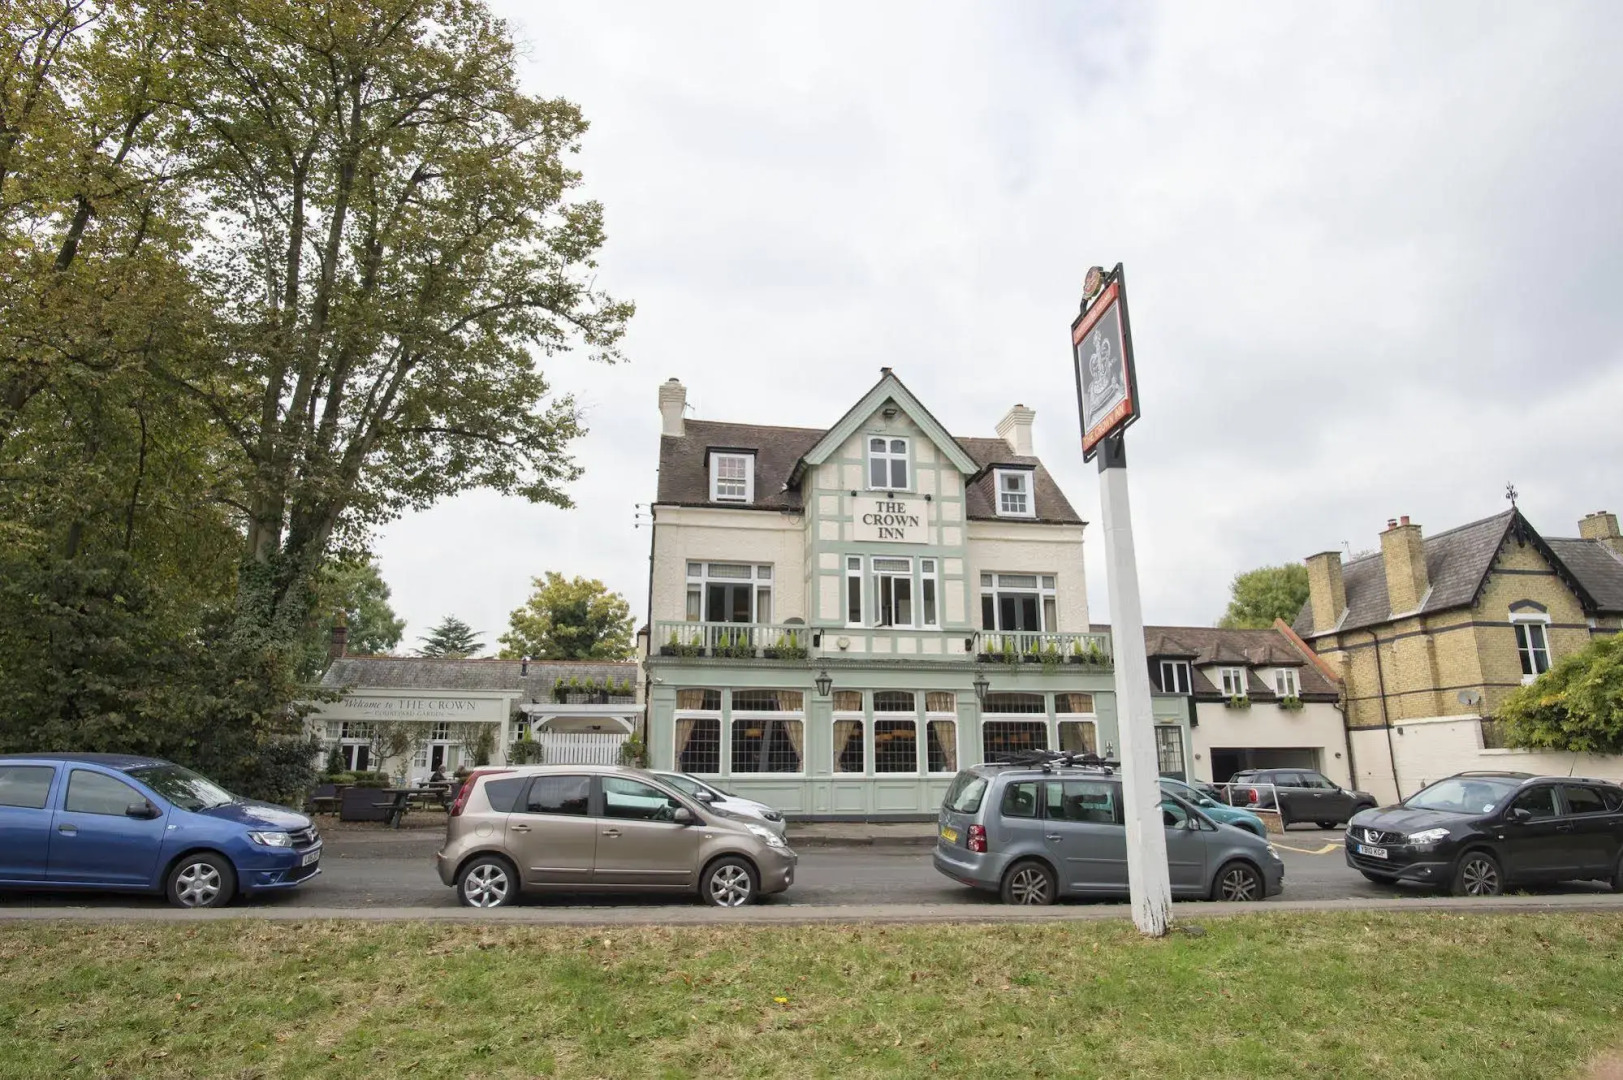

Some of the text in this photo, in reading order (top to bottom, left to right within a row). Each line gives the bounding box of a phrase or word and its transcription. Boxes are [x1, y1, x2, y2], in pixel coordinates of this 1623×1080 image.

[875, 501, 906, 513] THE
[862, 514, 919, 527] CROWN
[878, 527, 904, 539] INN
[343, 698, 381, 708] Welcome
[398, 699, 425, 709] THE
[429, 700, 476, 710] CROWN
